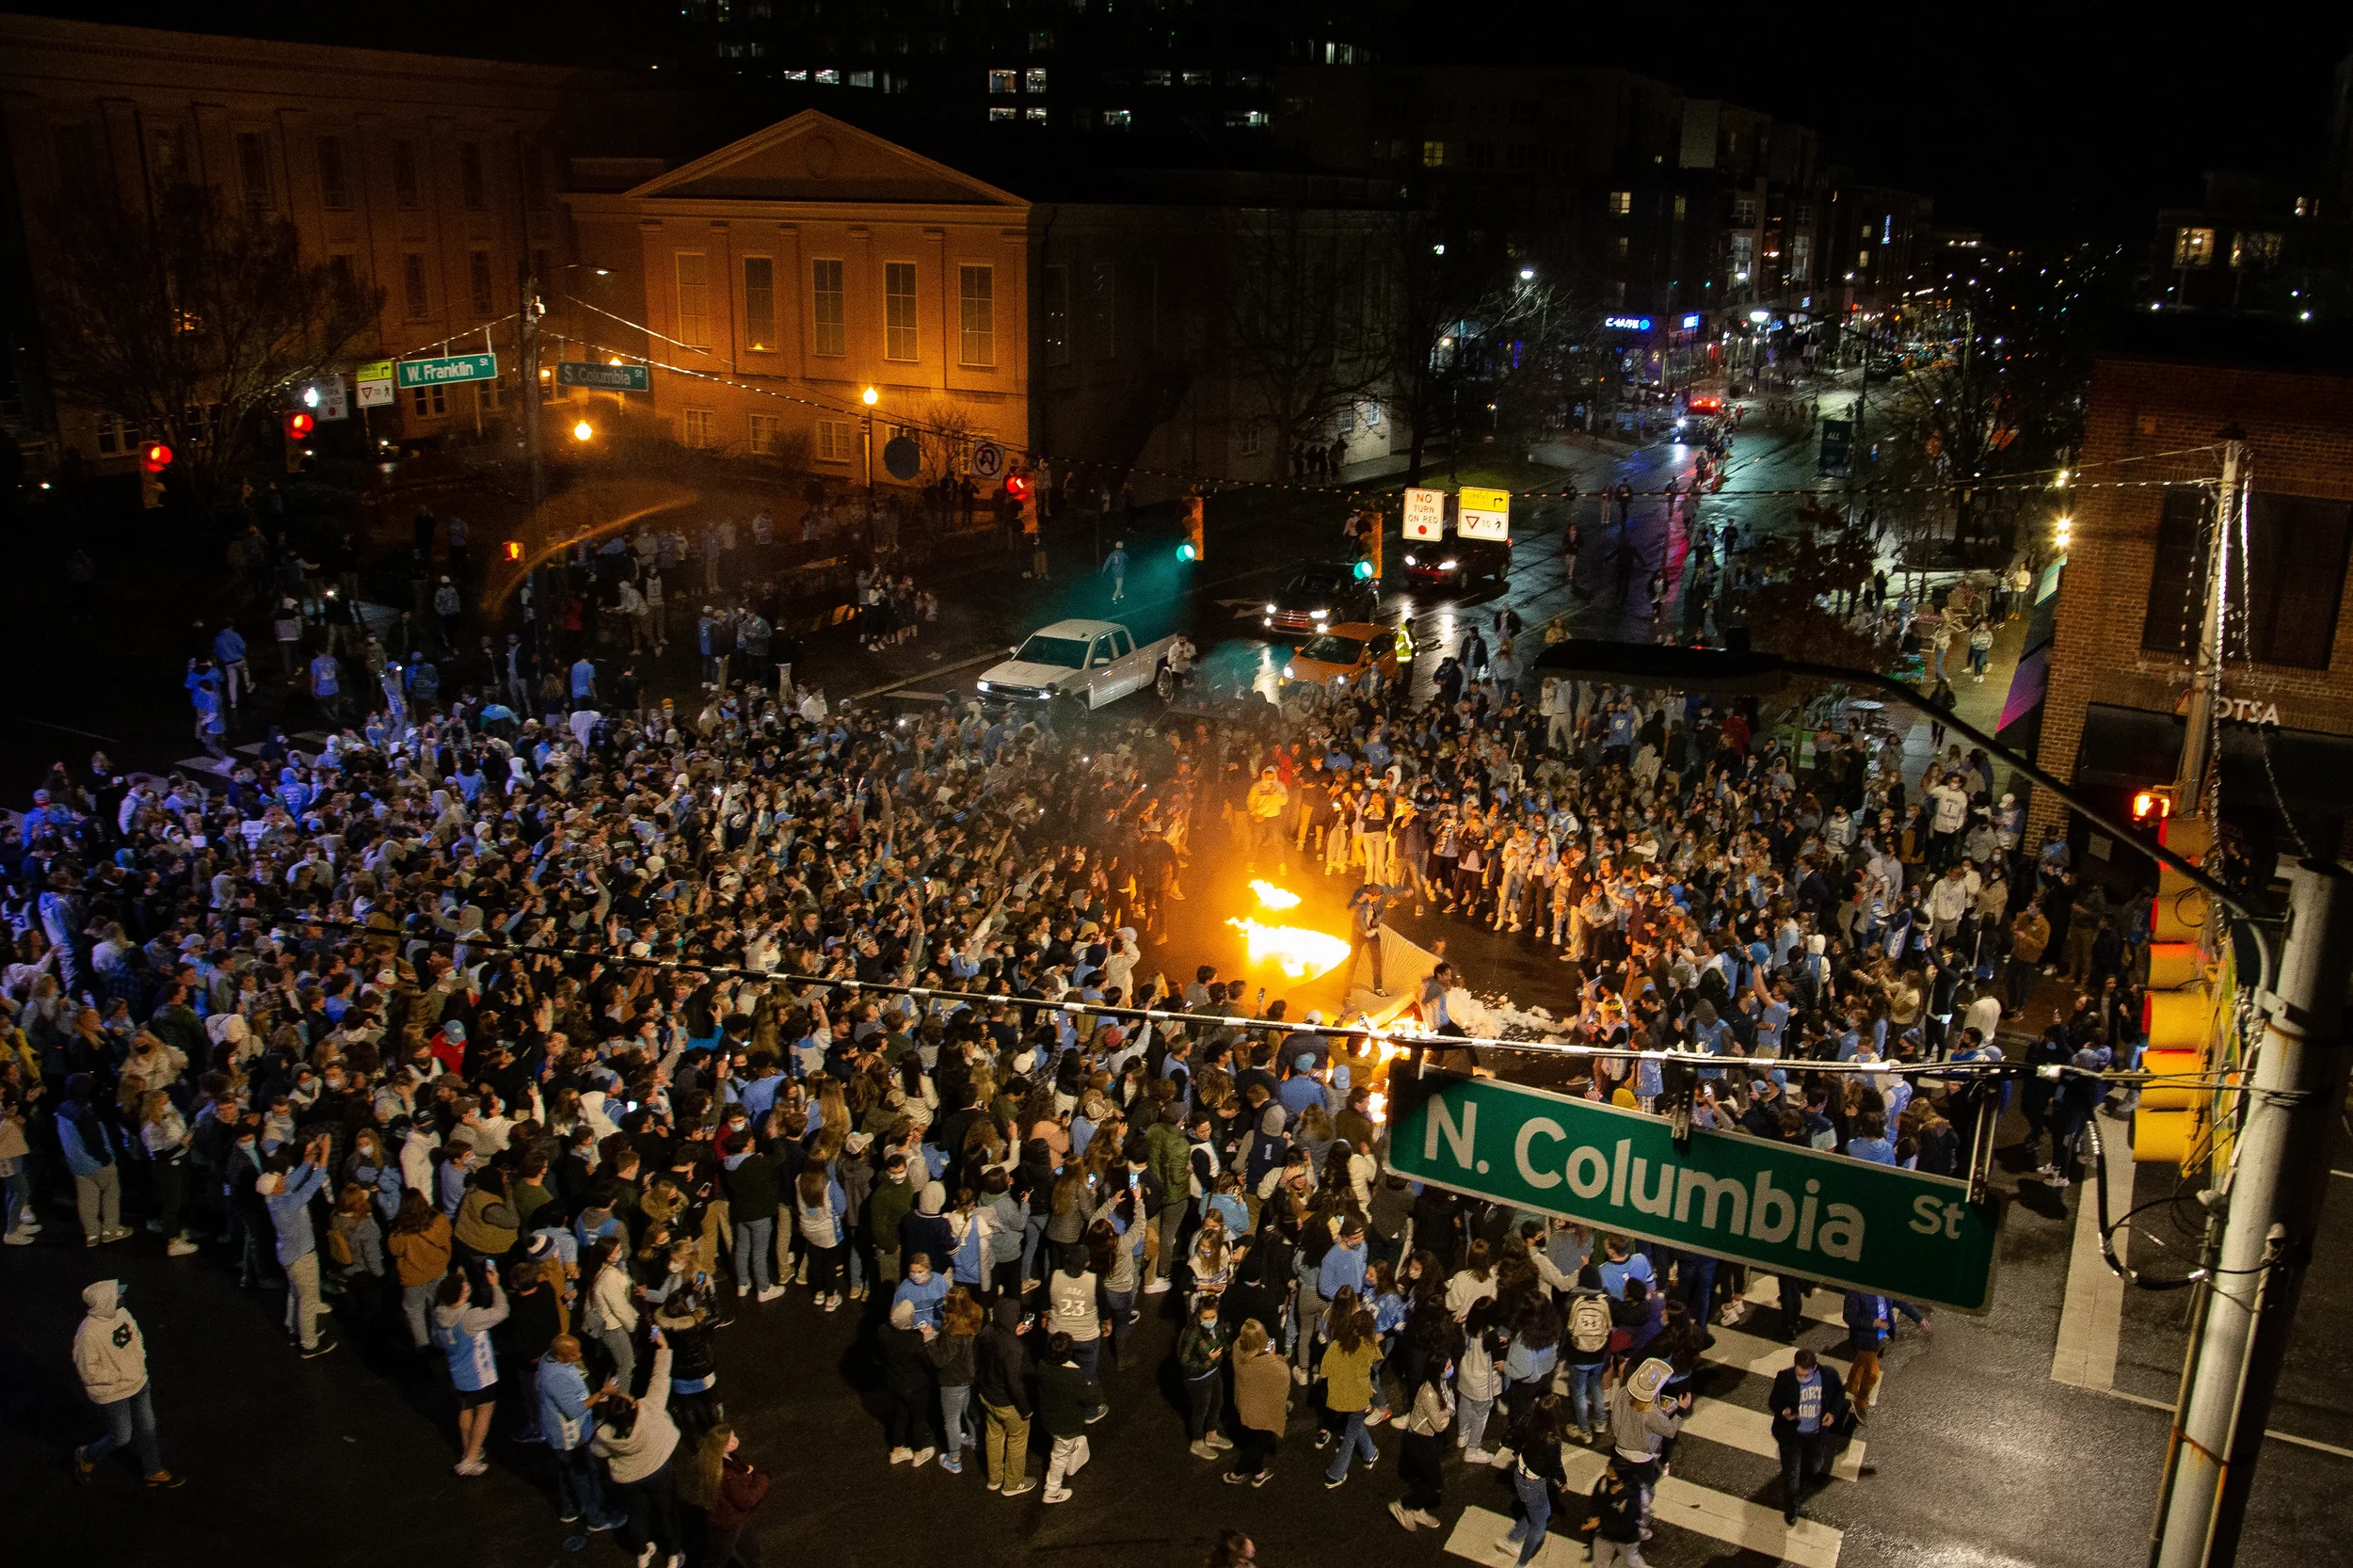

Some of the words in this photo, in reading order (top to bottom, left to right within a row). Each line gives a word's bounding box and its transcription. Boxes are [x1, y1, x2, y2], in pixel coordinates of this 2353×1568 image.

[407, 366, 423, 382] W.
[424, 361, 474, 380] Franklin
[479, 357, 489, 366] St
[578, 368, 632, 386] Columbia
[634, 369, 643, 378] St
[1416, 493, 1433, 504] NO
[1414, 504, 1435, 514] TURN
[1408, 514, 1419, 522] ON
[1422, 515, 1438, 524] RED
[1481, 520, 1492, 528] TO
[1264, 1144, 1273, 1160] 1
[1423, 1094, 1489, 1176] N.
[1513, 1115, 1865, 1263] Columbia
[1907, 1193, 1966, 1241] St
[1059, 1298, 1086, 1317] 23
